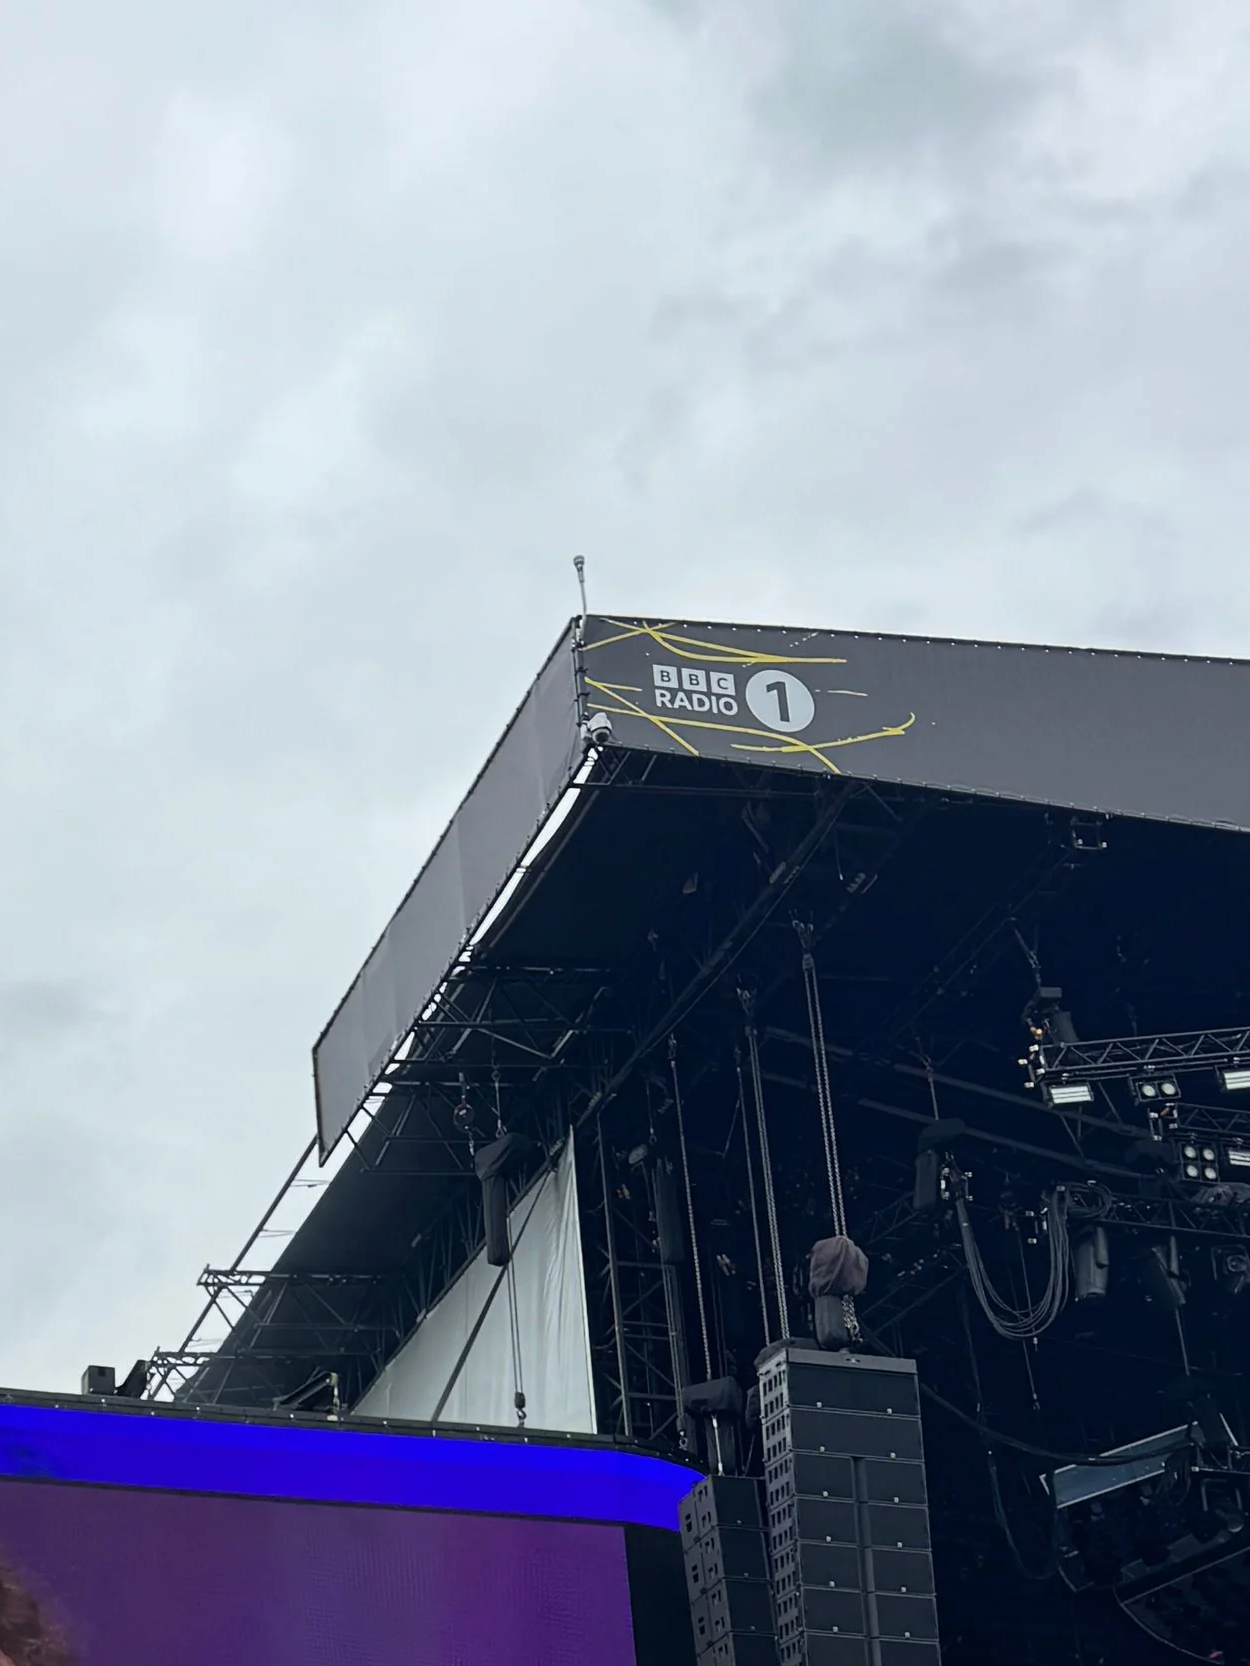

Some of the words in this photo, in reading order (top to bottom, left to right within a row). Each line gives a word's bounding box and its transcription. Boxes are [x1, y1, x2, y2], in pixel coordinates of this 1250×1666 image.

[656, 667, 732, 692] BBC
[655, 689, 738, 715] RADIO
[766, 681, 790, 723] 1
